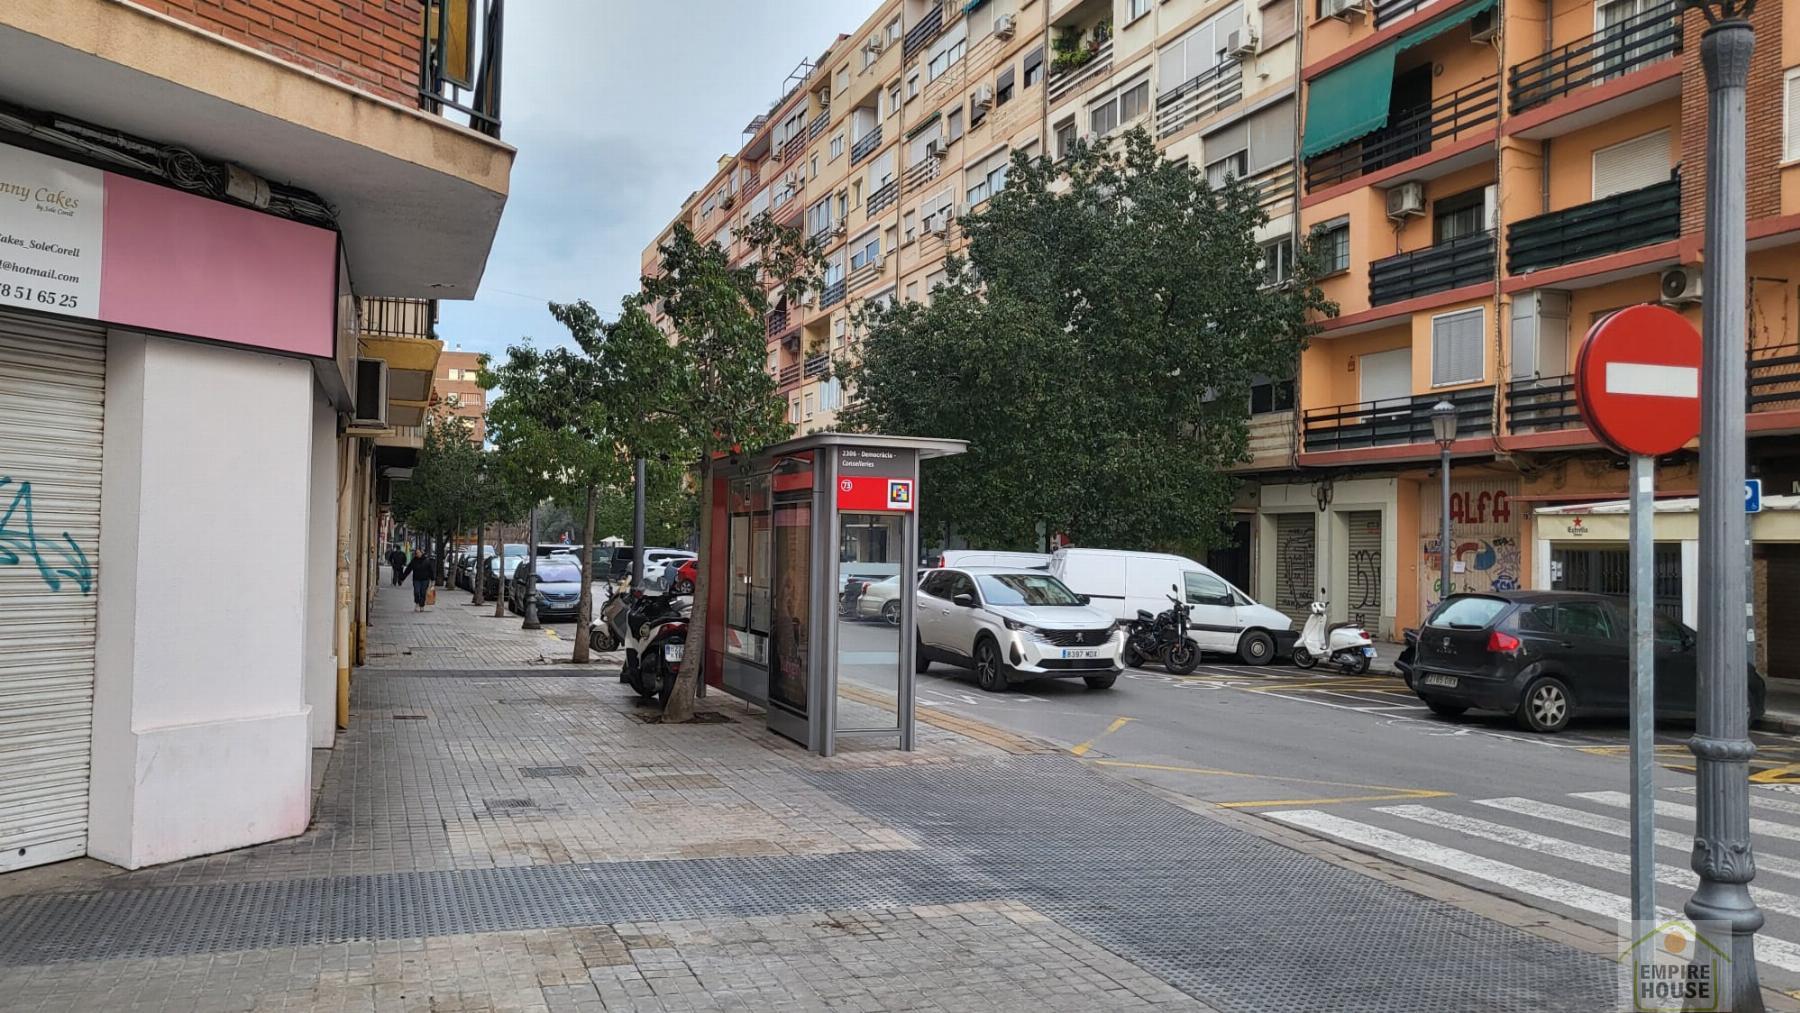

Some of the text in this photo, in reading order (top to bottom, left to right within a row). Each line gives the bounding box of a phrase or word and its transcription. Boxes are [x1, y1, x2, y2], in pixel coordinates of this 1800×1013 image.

[35, 187, 79, 209] Cakes
[14, 286, 32, 301] 51
[37, 290, 56, 304] 65
[59, 294, 78, 308] 25
[1450, 490, 1511, 524] ALFA
